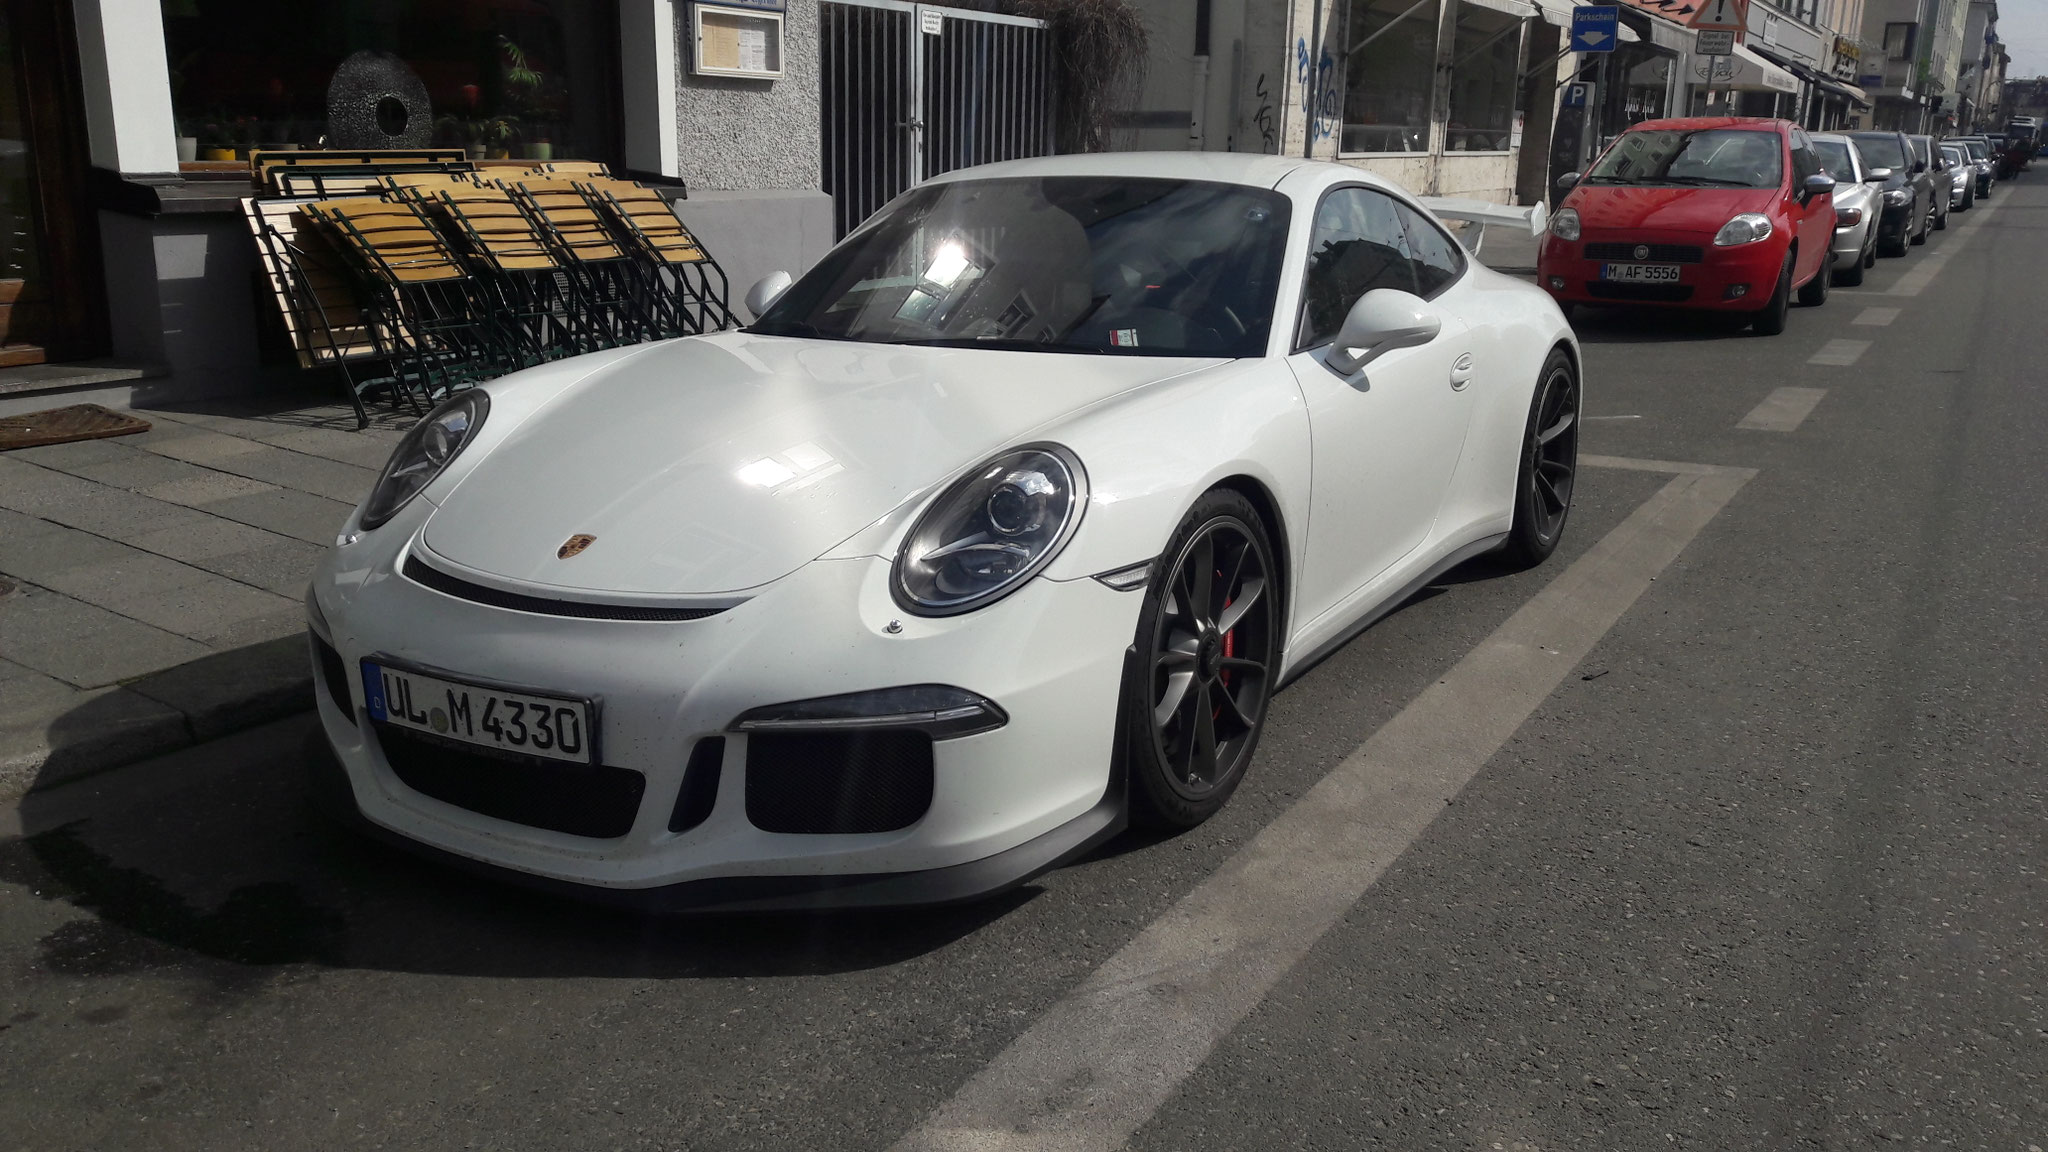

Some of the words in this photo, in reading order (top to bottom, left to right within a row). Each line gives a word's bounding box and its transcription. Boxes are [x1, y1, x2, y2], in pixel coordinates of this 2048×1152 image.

[1575, 12, 1615, 21] Parkschein
[1571, 85, 1585, 104] P
[1608, 265, 1617, 277] M
[1625, 266, 1642, 279] AF
[1644, 266, 1678, 280] 5556
[382, 673, 428, 725] UL
[446, 688, 473, 737] M
[481, 697, 581, 754] 4330
